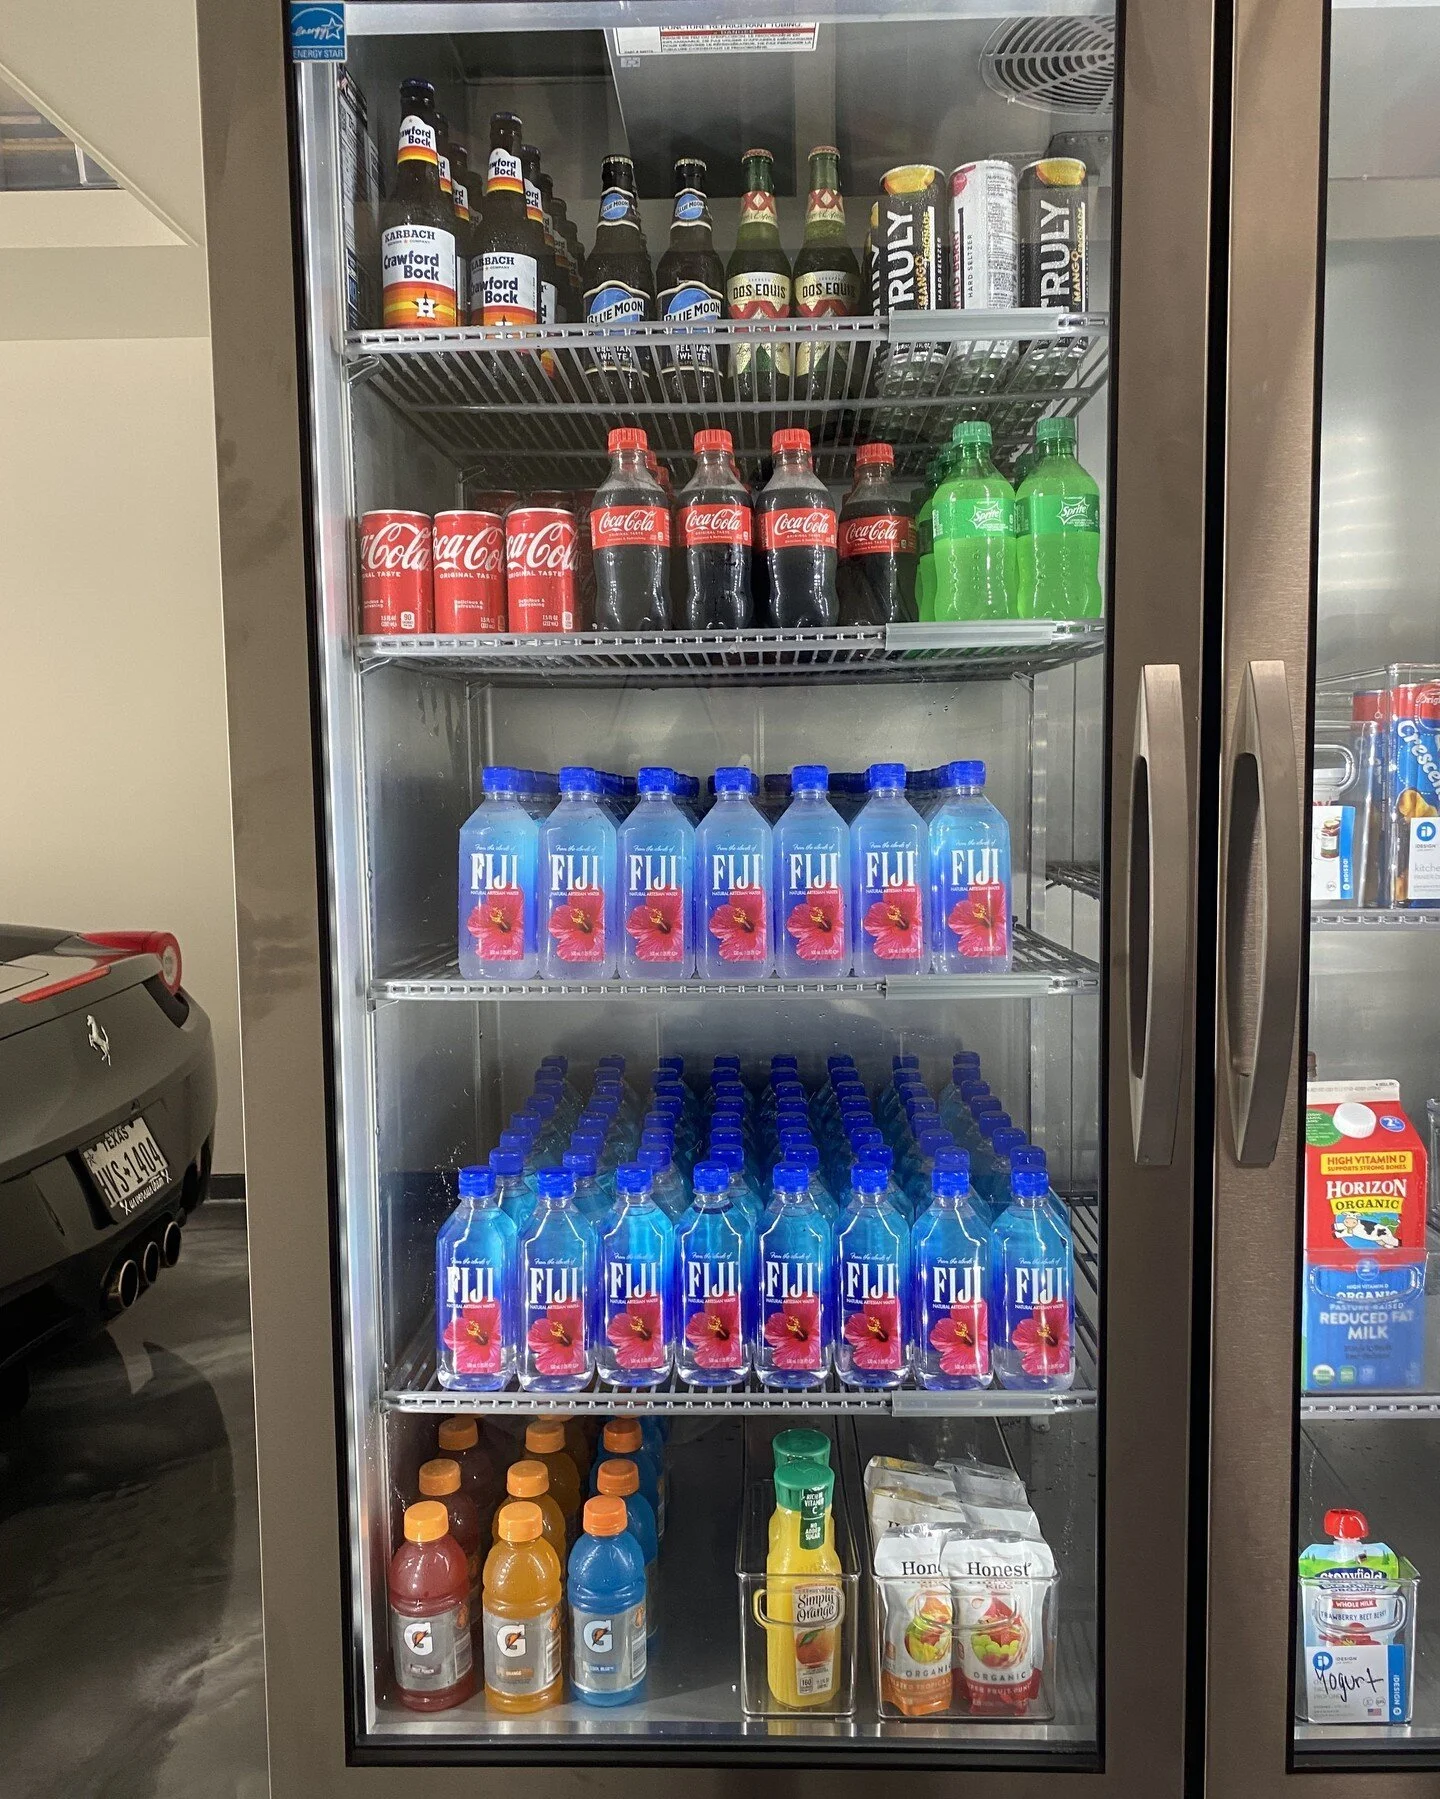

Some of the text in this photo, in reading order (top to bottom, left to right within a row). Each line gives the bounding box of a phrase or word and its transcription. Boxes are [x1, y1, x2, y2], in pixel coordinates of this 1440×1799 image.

[293, 49, 344, 59] ENERGY STAR
[401, 126, 431, 139] awford
[408, 136, 431, 148] Bock
[490, 158, 516, 169] wford
[494, 167, 516, 177] Bock
[384, 230, 436, 243] KARBACH
[384, 250, 439, 270] Crawford
[404, 265, 440, 281] Bock
[1070, 250, 1082, 303] MANGO
[485, 291, 519, 304] Bock
[733, 283, 787, 300] DOS EQUIS
[802, 282, 856, 299] DOS EQUIS
[588, 300, 643, 325] BLUE MOON
[694, 301, 720, 315] MOON
[680, 353, 707, 361] WHTE
[685, 508, 742, 533] Coca-Cola
[973, 510, 1000, 522] Sprite
[1061, 505, 1087, 517] Sprite
[599, 510, 657, 534] Coca-Cola
[773, 512, 830, 536] Coca-Cola
[846, 519, 901, 544] Coca-Cola
[1416, 692, 1440, 706] Orig
[470, 853, 518, 890] FIJI
[551, 854, 598, 891] FIJI
[629, 854, 677, 891] FIJI
[712, 854, 760, 891] FIJI
[790, 852, 838, 890] FIJI
[866, 851, 916, 889] FIJI
[951, 848, 999, 886] FIJI
[103, 1128, 130, 1152] TEXAS
[1327, 1155, 1406, 1165] HIGH VITAMIN D
[95, 1161, 130, 1204] HVS
[123, 1137, 165, 1184] 1404
[1326, 1178, 1407, 1200] HORIZON
[1335, 1199, 1400, 1211] ORGANIC
[446, 1266, 494, 1304] FIJI
[529, 1267, 578, 1304] FIJI
[609, 1261, 657, 1298] FIJI
[687, 1261, 736, 1298] FIJI
[766, 1261, 814, 1298] FIJI
[846, 1261, 895, 1299] FIJI
[933, 1266, 982, 1304] FIJI
[1015, 1266, 1063, 1304] FIJI
[1336, 1290, 1398, 1301] ORGANIC
[1329, 1302, 1404, 1311] PASTURE-RAISED
[1320, 1309, 1415, 1325] REDUCED FAT
[1348, 1325, 1388, 1340] MILK
[812, 1506, 818, 1514] C
[901, 1561, 941, 1576] Hon
[967, 1561, 1028, 1577] Honest
[797, 1593, 834, 1609] Simply
[1335, 1599, 1374, 1608] WHOLE MILK
[796, 1604, 834, 1623] Orange
[1360, 1612, 1373, 1620] BEET
[403, 1621, 434, 1656] G
[496, 1624, 527, 1658] G
[583, 1619, 613, 1653] G
[801, 1678, 812, 1687] 160
[974, 1671, 1026, 1681] ORGANIC
[1314, 1657, 1384, 1703] Yogurt
